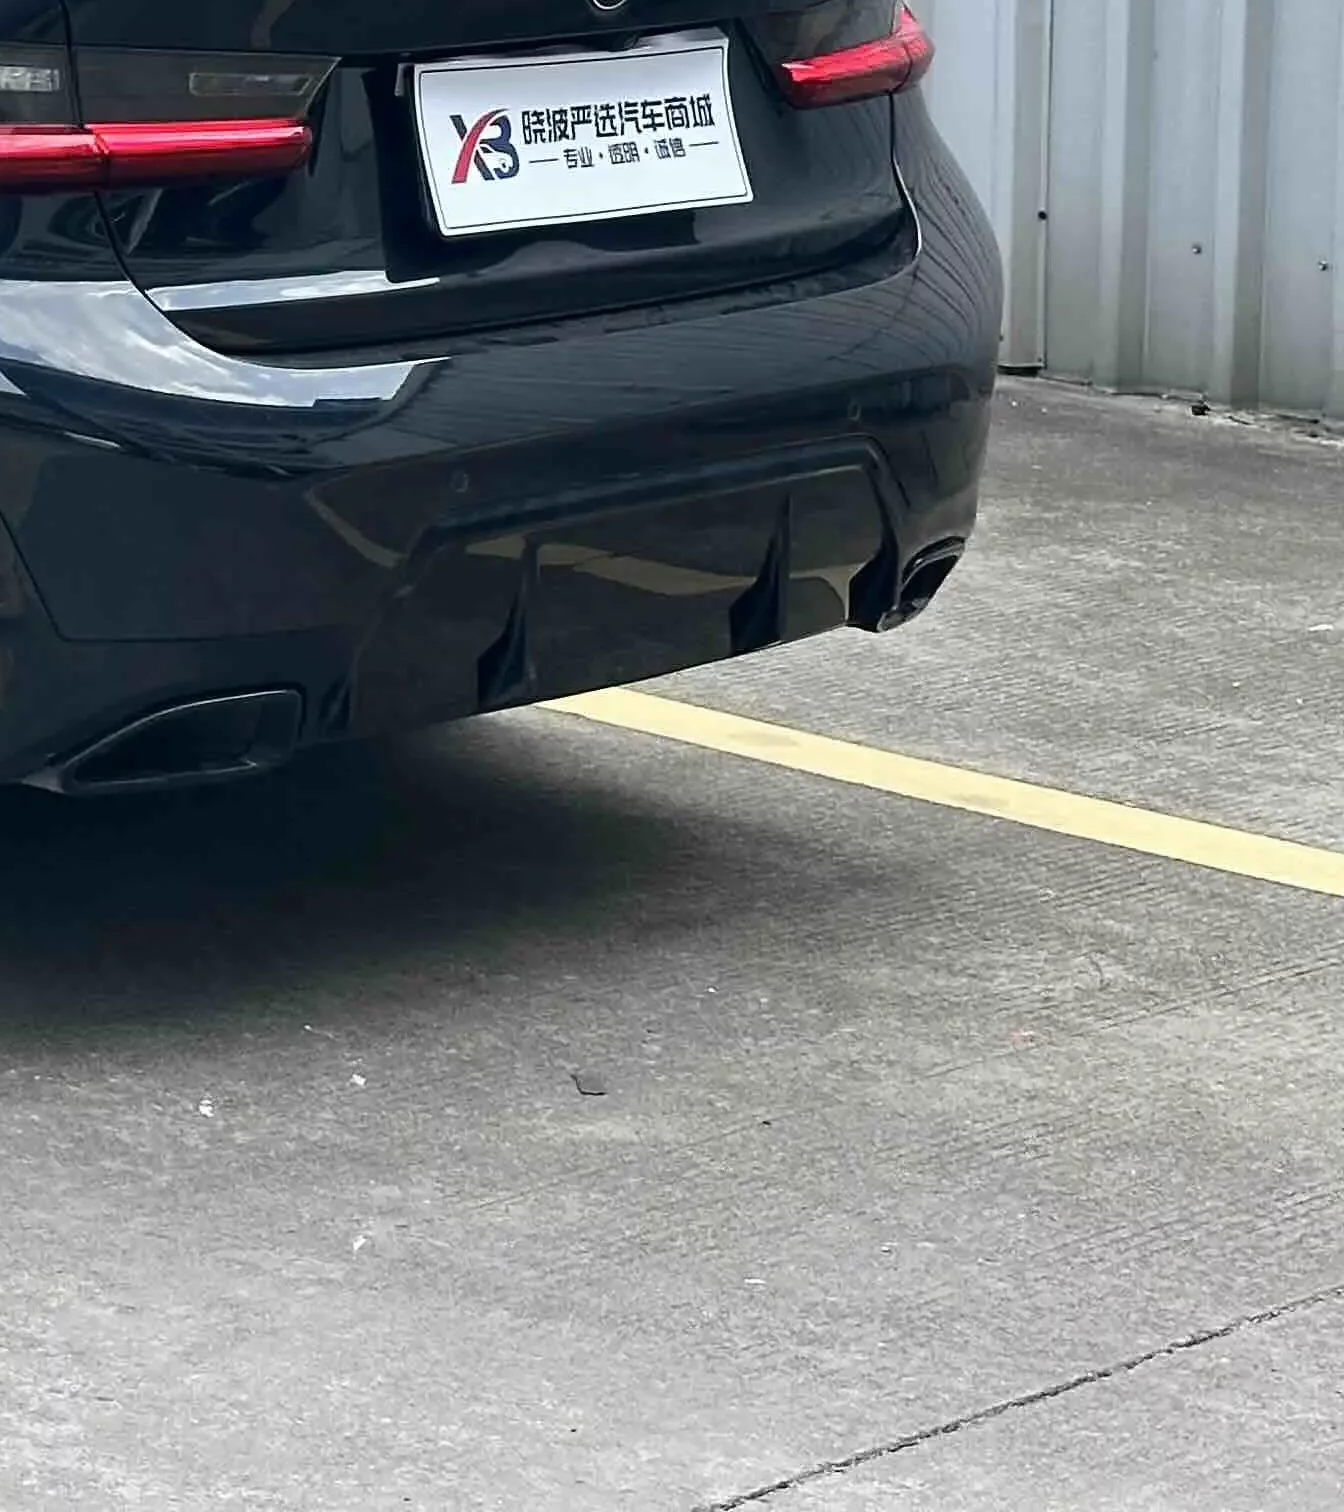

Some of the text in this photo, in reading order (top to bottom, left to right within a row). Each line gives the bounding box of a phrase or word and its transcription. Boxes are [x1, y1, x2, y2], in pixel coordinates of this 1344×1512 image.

[521, 93, 716, 145] 晓波严选汽车商城
